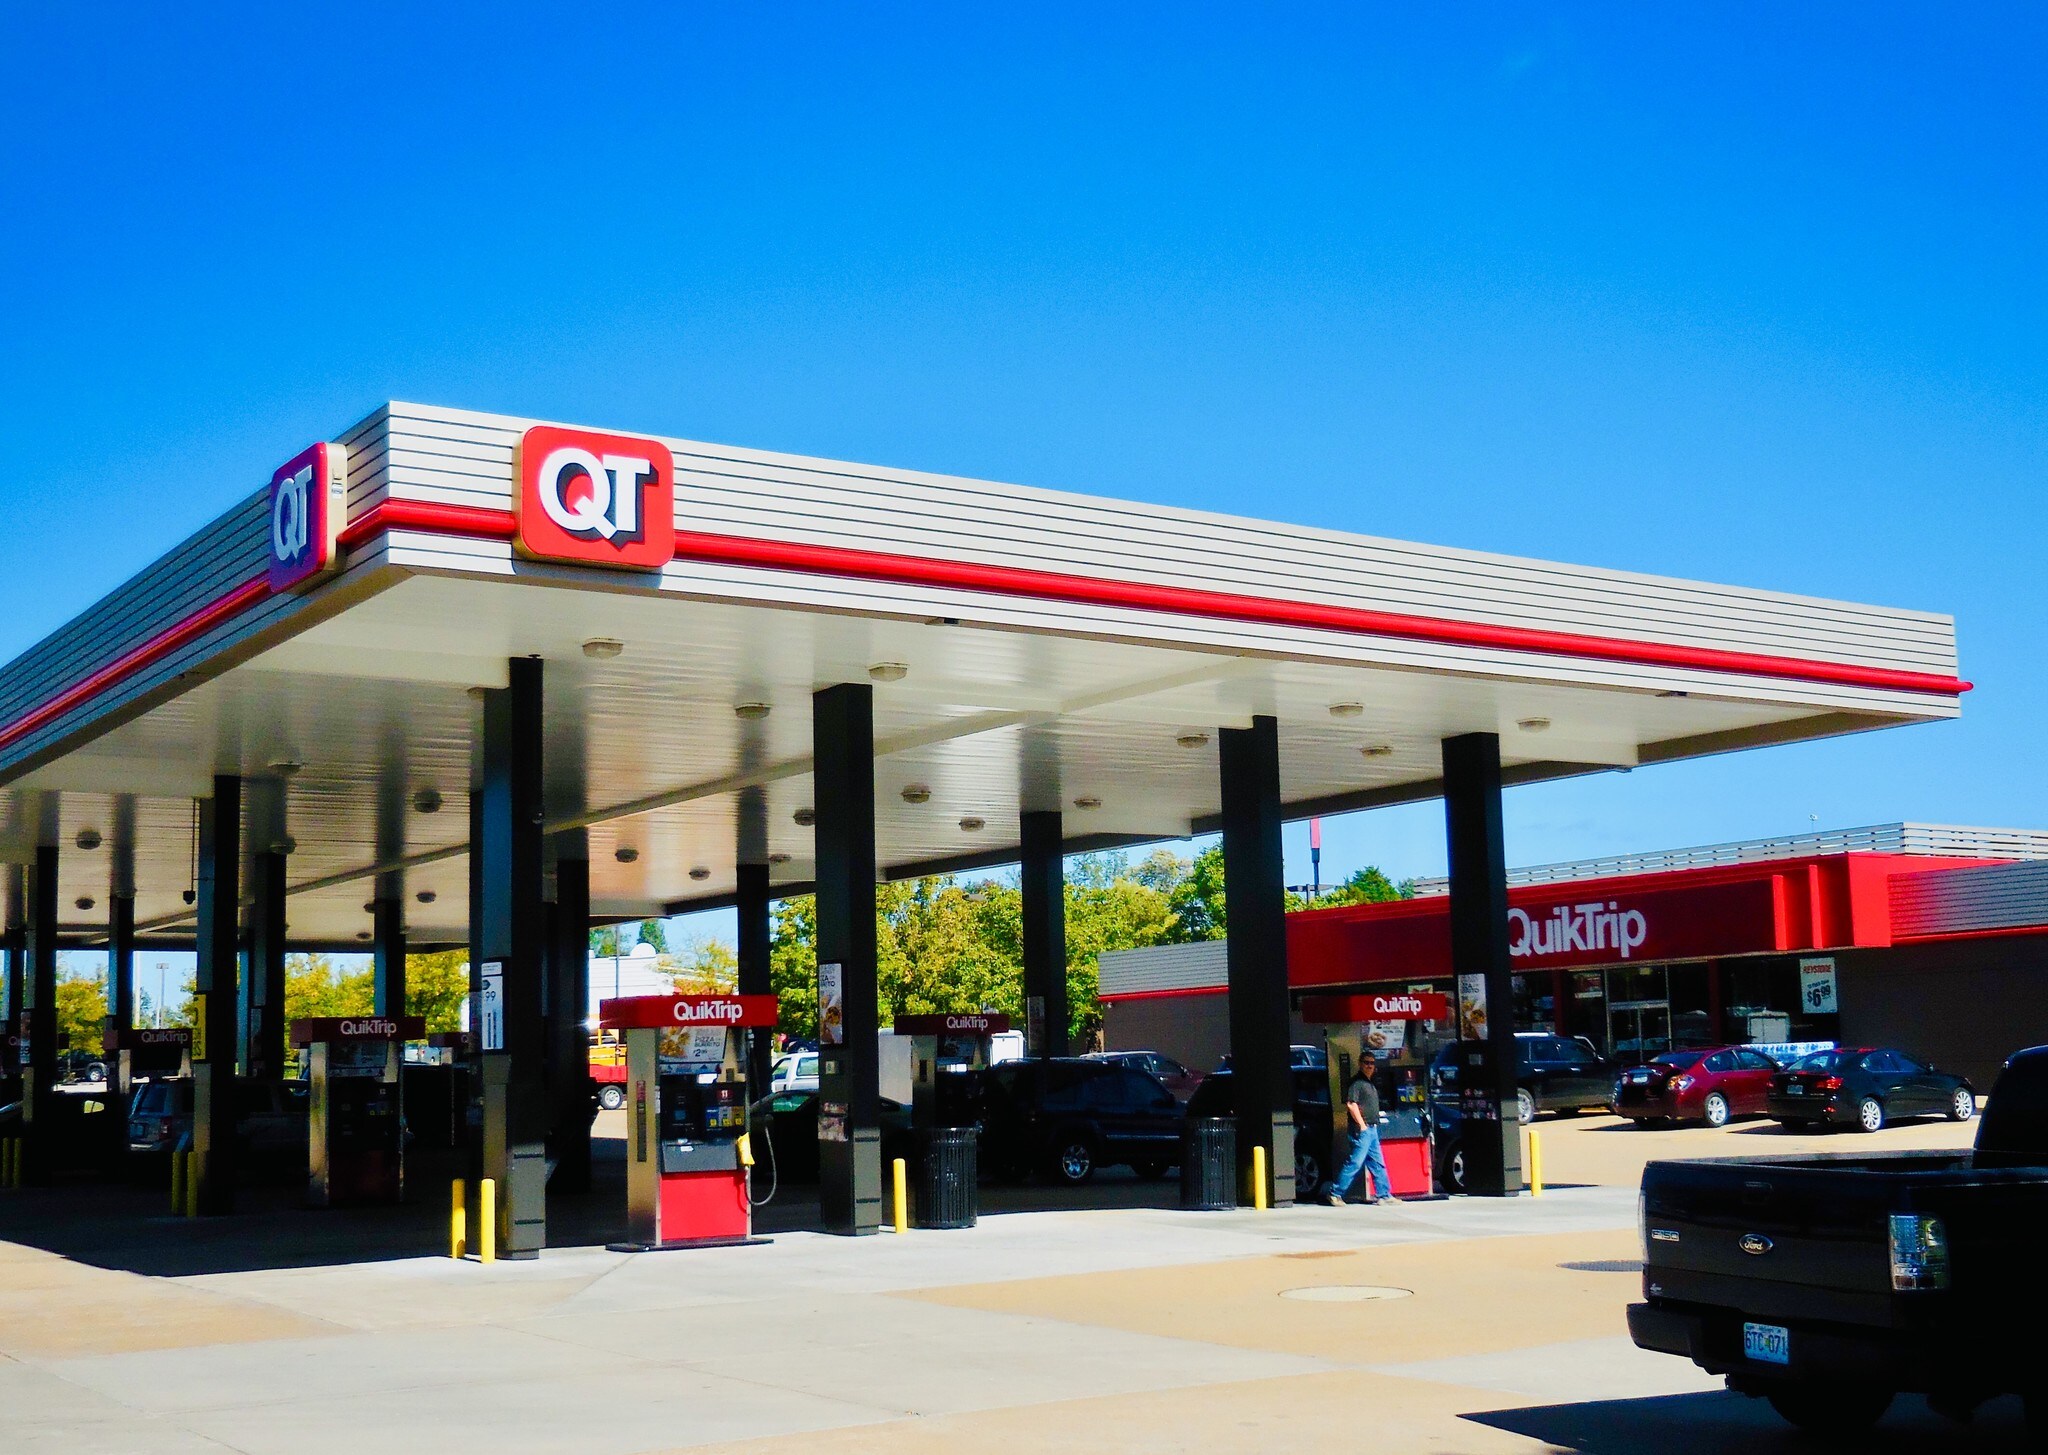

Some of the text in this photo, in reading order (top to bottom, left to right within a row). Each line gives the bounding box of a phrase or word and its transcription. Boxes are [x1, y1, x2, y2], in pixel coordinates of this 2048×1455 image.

[540, 447, 651, 540] QT
[274, 464, 312, 560] QT
[1507, 901, 1647, 958] QuikTrip
[674, 1000, 743, 1023] QuikTrip
[1373, 996, 1422, 1016] QuikTrip
[340, 1019, 397, 1037] QuikTrip
[946, 1016, 988, 1031] QuikTrip
[141, 1030, 188, 1044] QuikTrip
[1744, 1237, 1764, 1251] Ford
